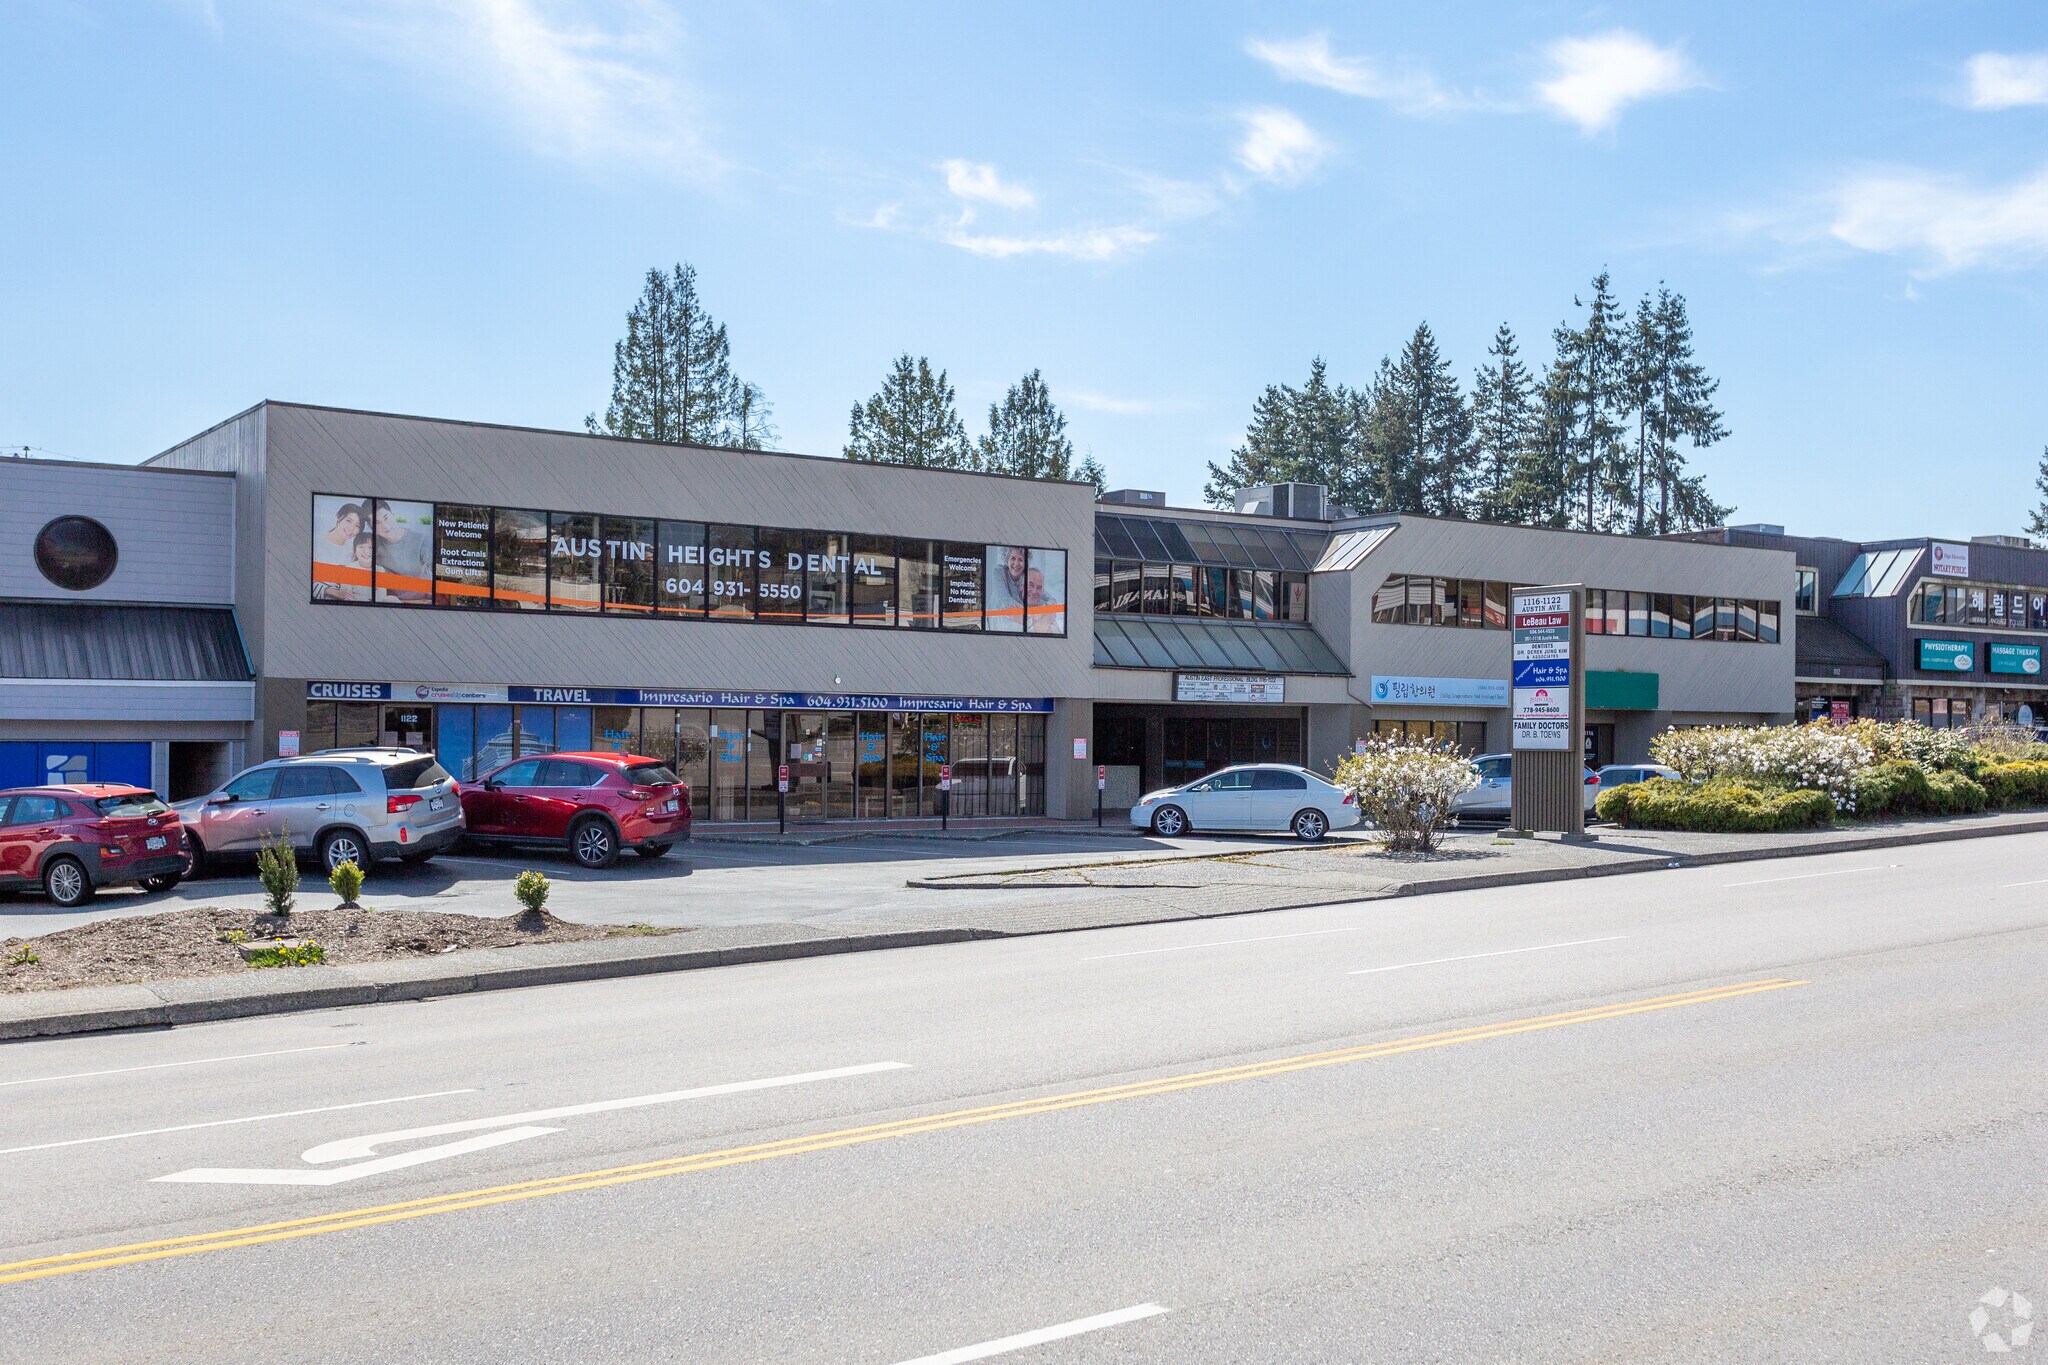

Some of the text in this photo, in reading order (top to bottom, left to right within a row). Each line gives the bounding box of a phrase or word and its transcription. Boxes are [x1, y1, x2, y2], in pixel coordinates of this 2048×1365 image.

[438, 520, 489, 530] New Patients
[445, 530, 482, 539] Welcome
[440, 548, 486, 558] Root Canals
[552, 537, 882, 576] AUSTIN HEIGHTS DENTAL
[441, 558, 485, 567] Extractions
[944, 555, 981, 564] Emergencies
[445, 567, 482, 576] Gum Lifts
[949, 564, 977, 572] Welcome
[1952, 565, 1967, 575] PUBLIC
[665, 578, 801, 600] 604 931- 5550
[950, 580, 975, 588] Implants
[948, 596, 977, 604] Dentures!
[1523, 597, 1561, 606] 1116-1122
[1523, 616, 1562, 626] LeBeau Law
[1924, 643, 1968, 652] PHYSIOTHERAPY
[1992, 646, 2039, 656] MASSAGE THERAPY
[1555, 666, 1567, 675] Spa
[310, 683, 381, 698] CRUISES
[533, 688, 591, 702] TRAVEL
[1392, 682, 1436, 698] 필립한의원
[639, 690, 1032, 711] Impresario Hair & Spa 604.931.5100 Impresario Hair & Spa
[401, 714, 418, 723] 1122
[604, 730, 631, 740] Hair
[719, 731, 745, 740] Hair
[860, 731, 885, 741] Hair
[924, 732, 947, 742] Hair
[867, 743, 876, 751] &
[930, 743, 940, 751] &
[720, 752, 742, 763] Spa
[862, 753, 882, 764] Spa
[925, 753, 945, 764] Spa
